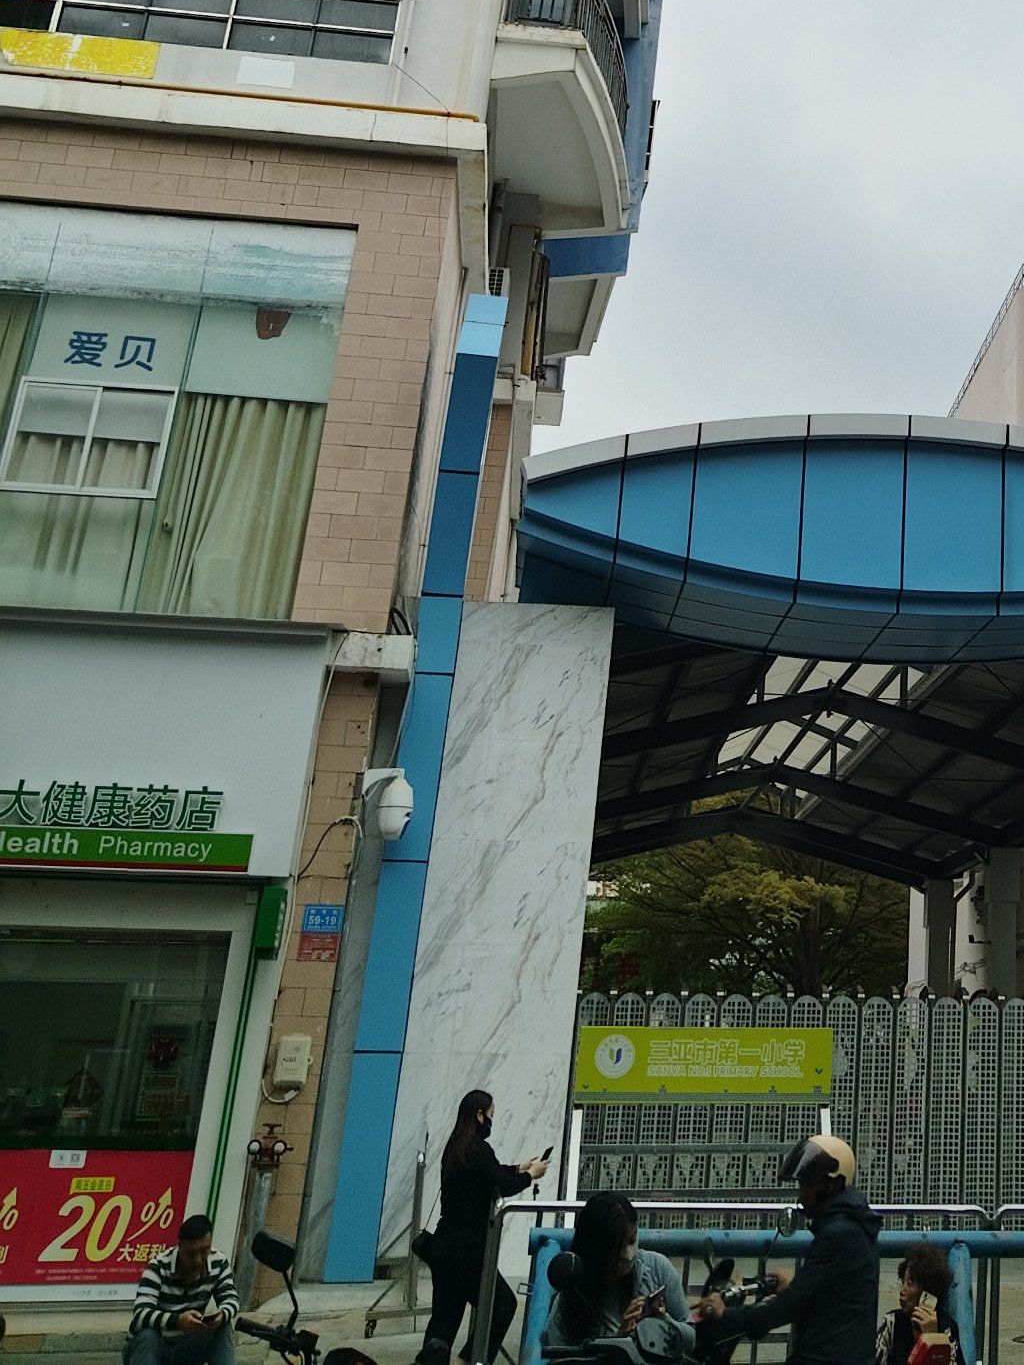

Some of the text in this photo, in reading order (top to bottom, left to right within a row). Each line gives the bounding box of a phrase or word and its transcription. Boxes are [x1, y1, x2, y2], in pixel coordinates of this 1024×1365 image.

[64, 331, 156, 371] 爱贝
[0, 779, 224, 831] 大健康药店
[0, 832, 212, 862] ealth Pharmacy
[308, 915, 337, 925] 59-19
[648, 1039, 805, 1065] 三亚市第一小学
[647, 1065, 686, 1077] SANYA
[713, 1065, 757, 1077] PRIMARY
[760, 1065, 803, 1077] SCHOOL
